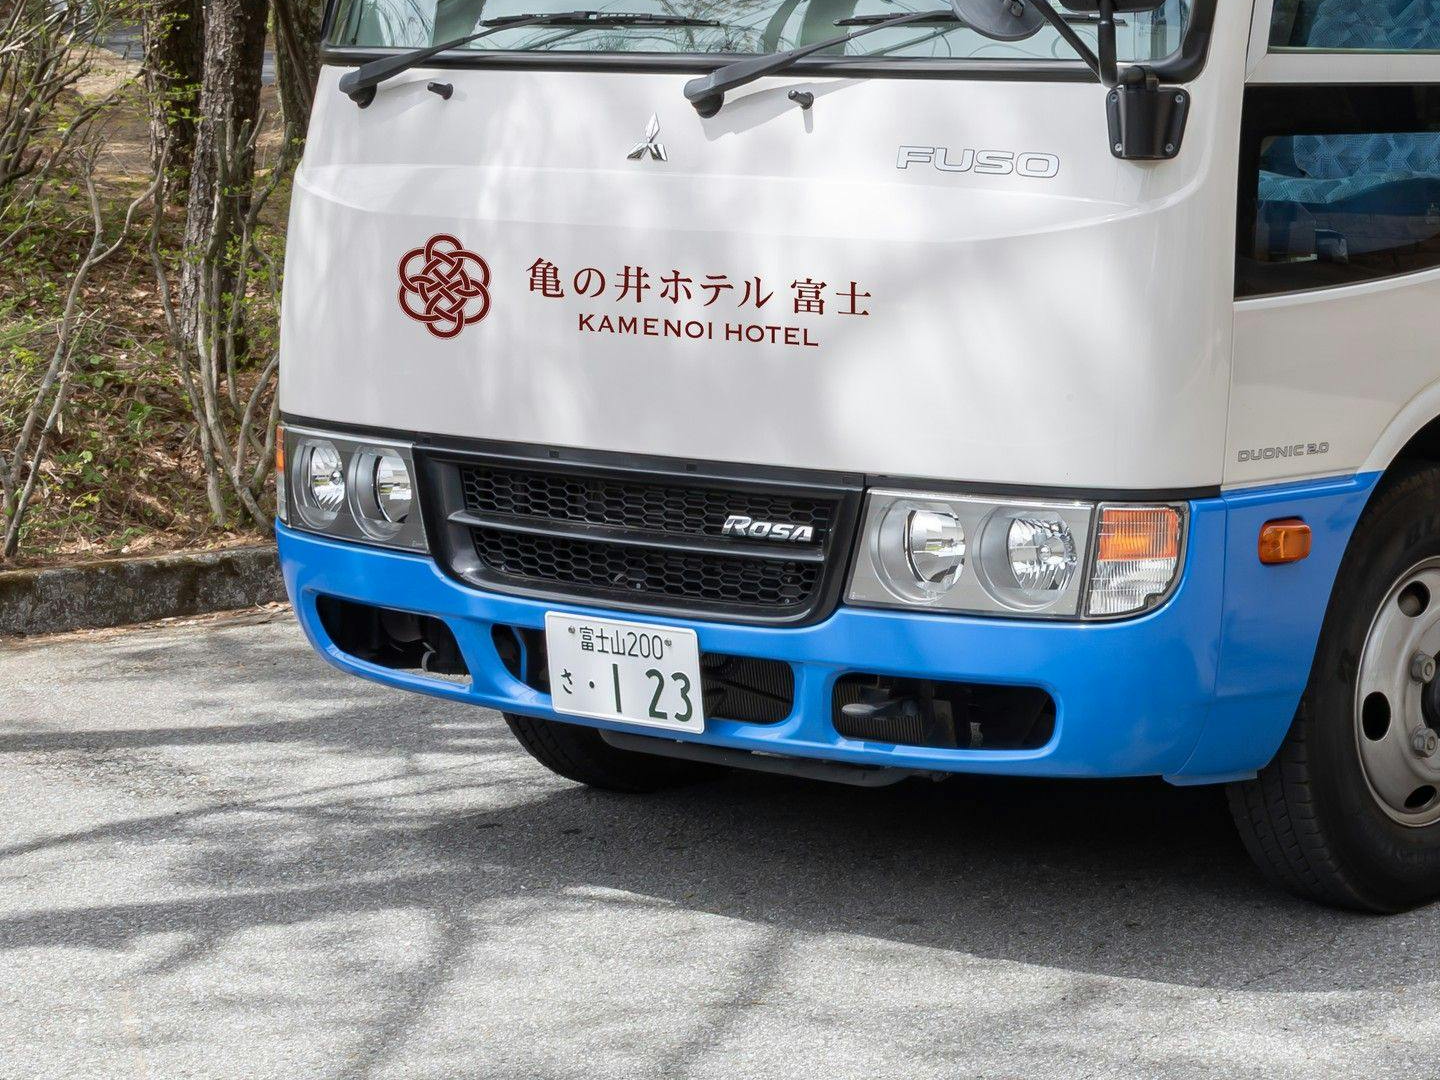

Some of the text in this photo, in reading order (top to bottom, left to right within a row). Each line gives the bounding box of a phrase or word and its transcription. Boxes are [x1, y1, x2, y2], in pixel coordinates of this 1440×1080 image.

[896, 145, 1060, 178] FUSO
[526, 257, 872, 316] 亀の井ホテル 富士
[578, 313, 819, 347] KAMENOI HOTEL
[1238, 445, 1304, 462] DUONIC
[722, 514, 814, 542] ROSA
